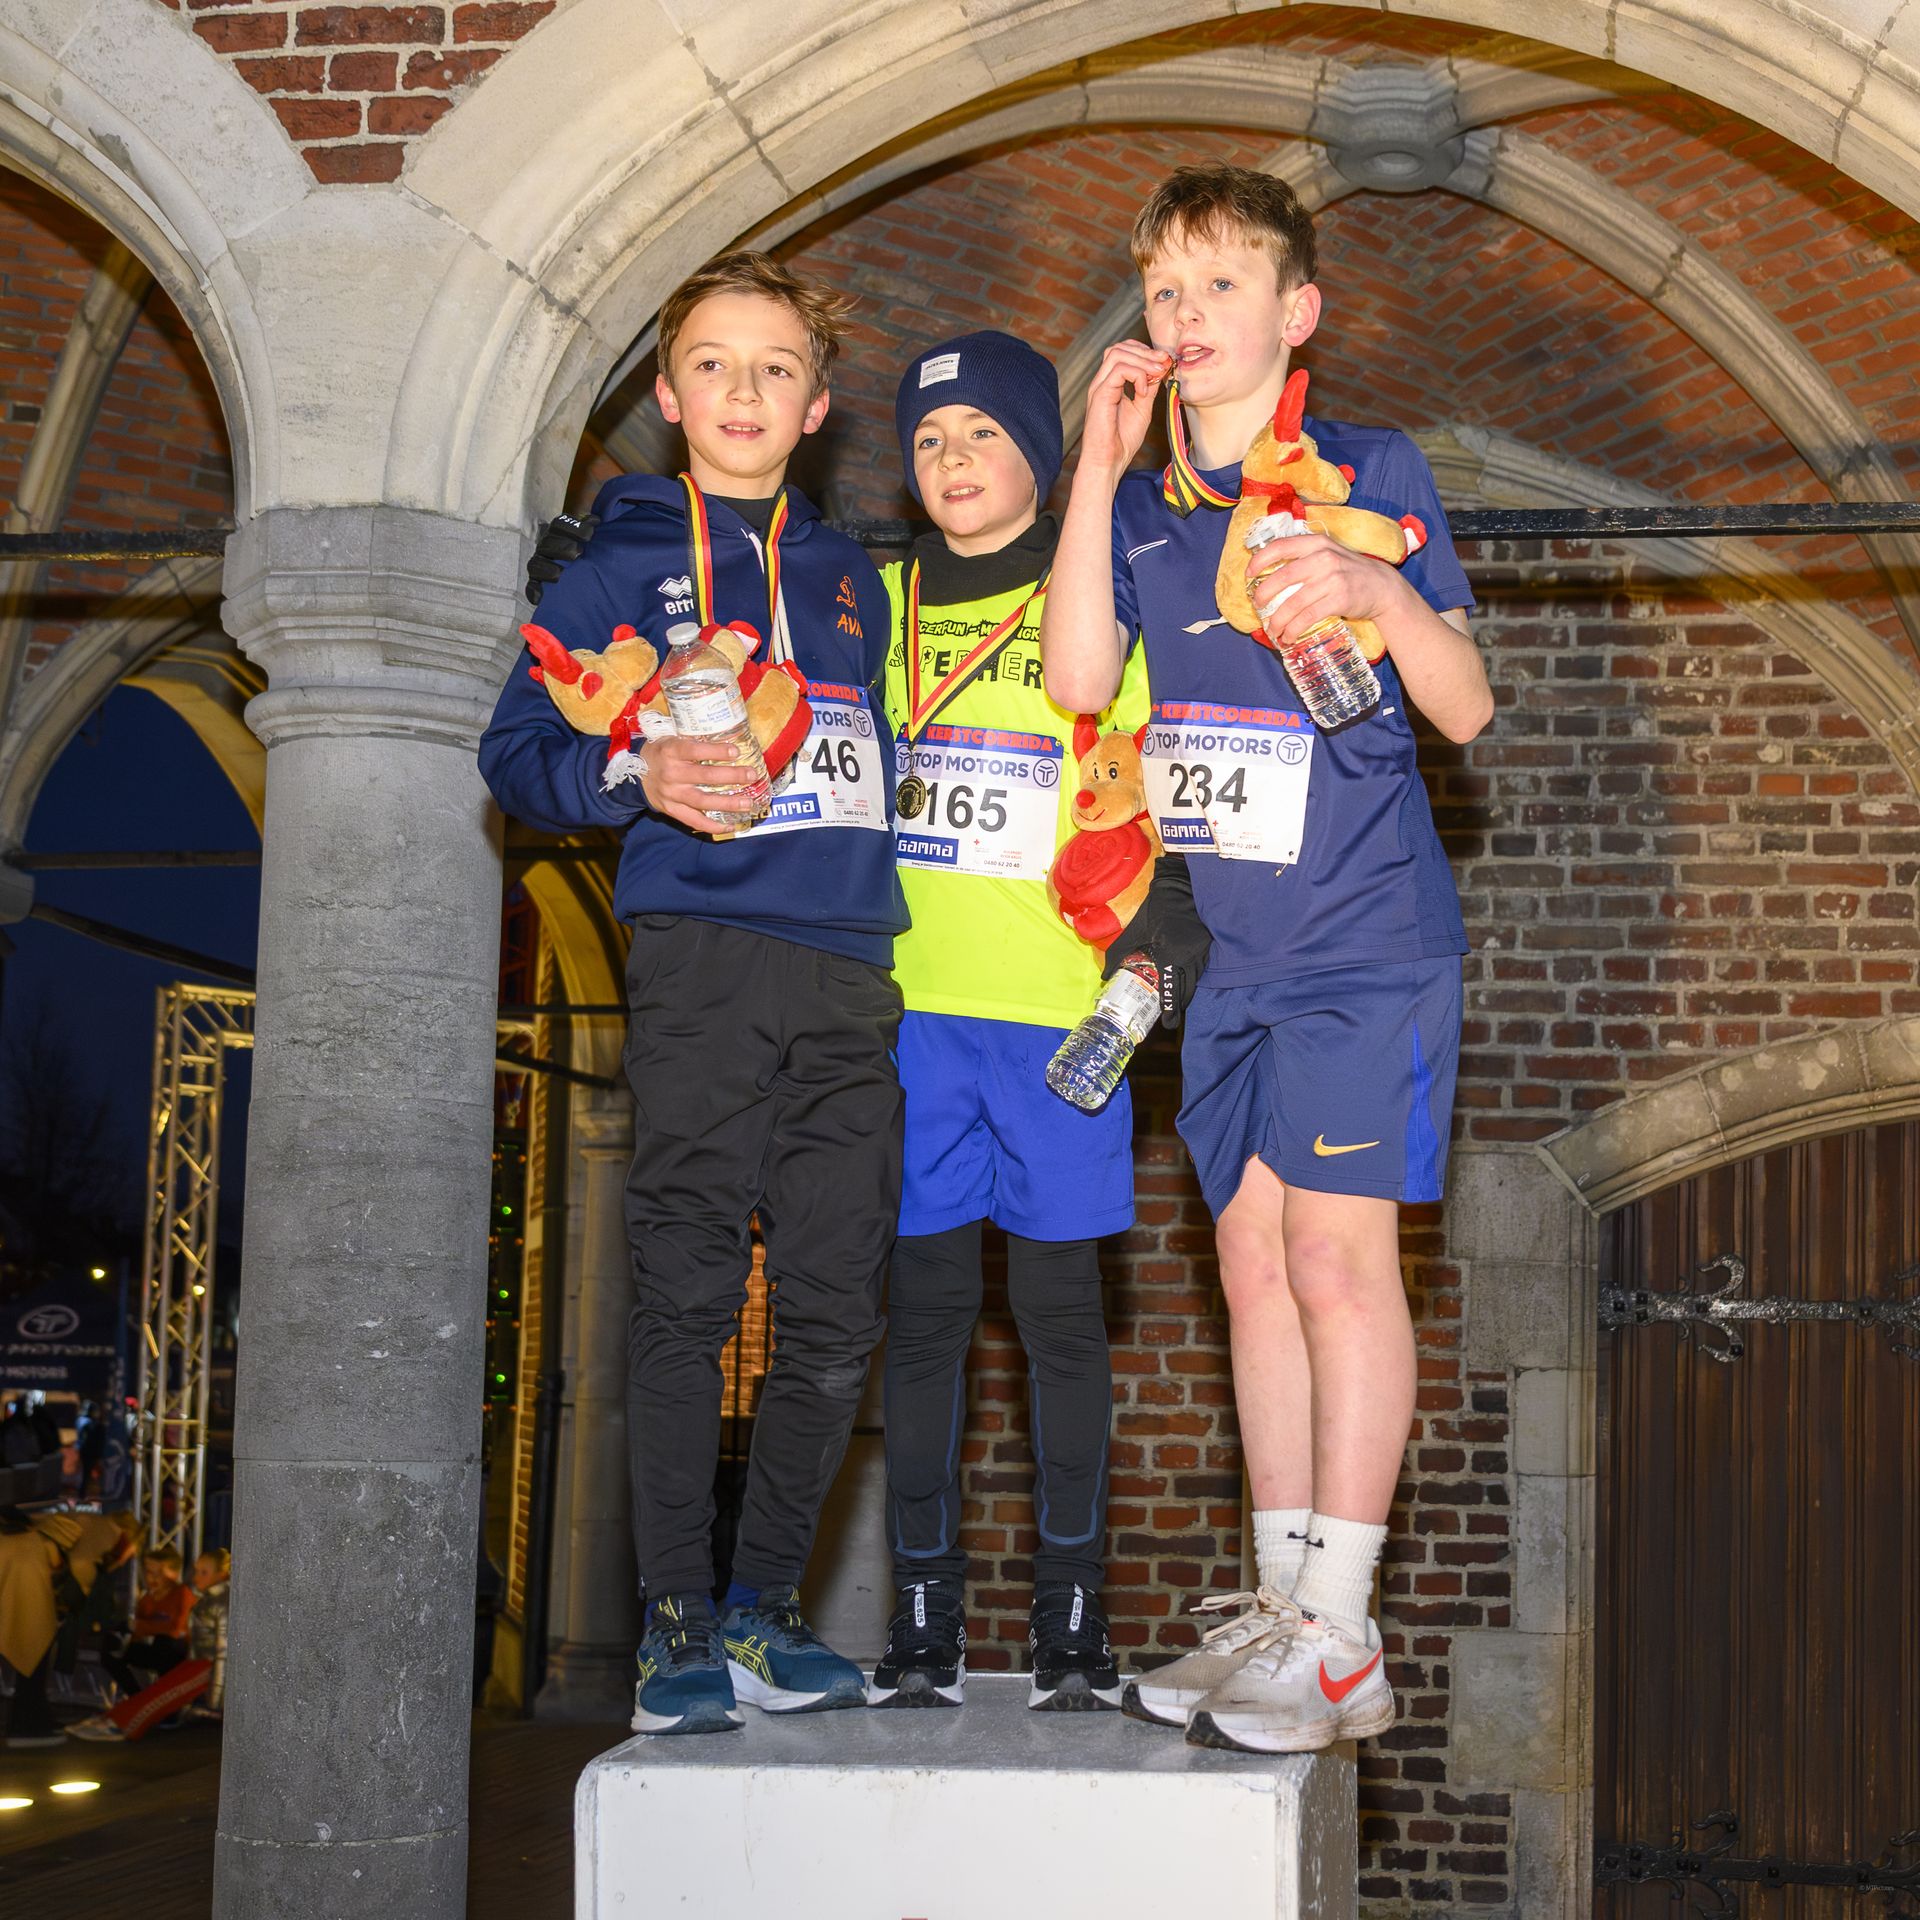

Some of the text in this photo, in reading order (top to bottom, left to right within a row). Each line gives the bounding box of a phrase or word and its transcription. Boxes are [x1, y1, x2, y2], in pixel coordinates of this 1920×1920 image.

[814, 710, 852, 727] TORS
[1155, 733, 1272, 756] TOP MOTORS
[914, 752, 1029, 779] TOP MOTORS
[1168, 763, 1248, 813] 234
[926, 782, 1008, 832] 165
[1163, 964, 1174, 1011] KIPSTA
